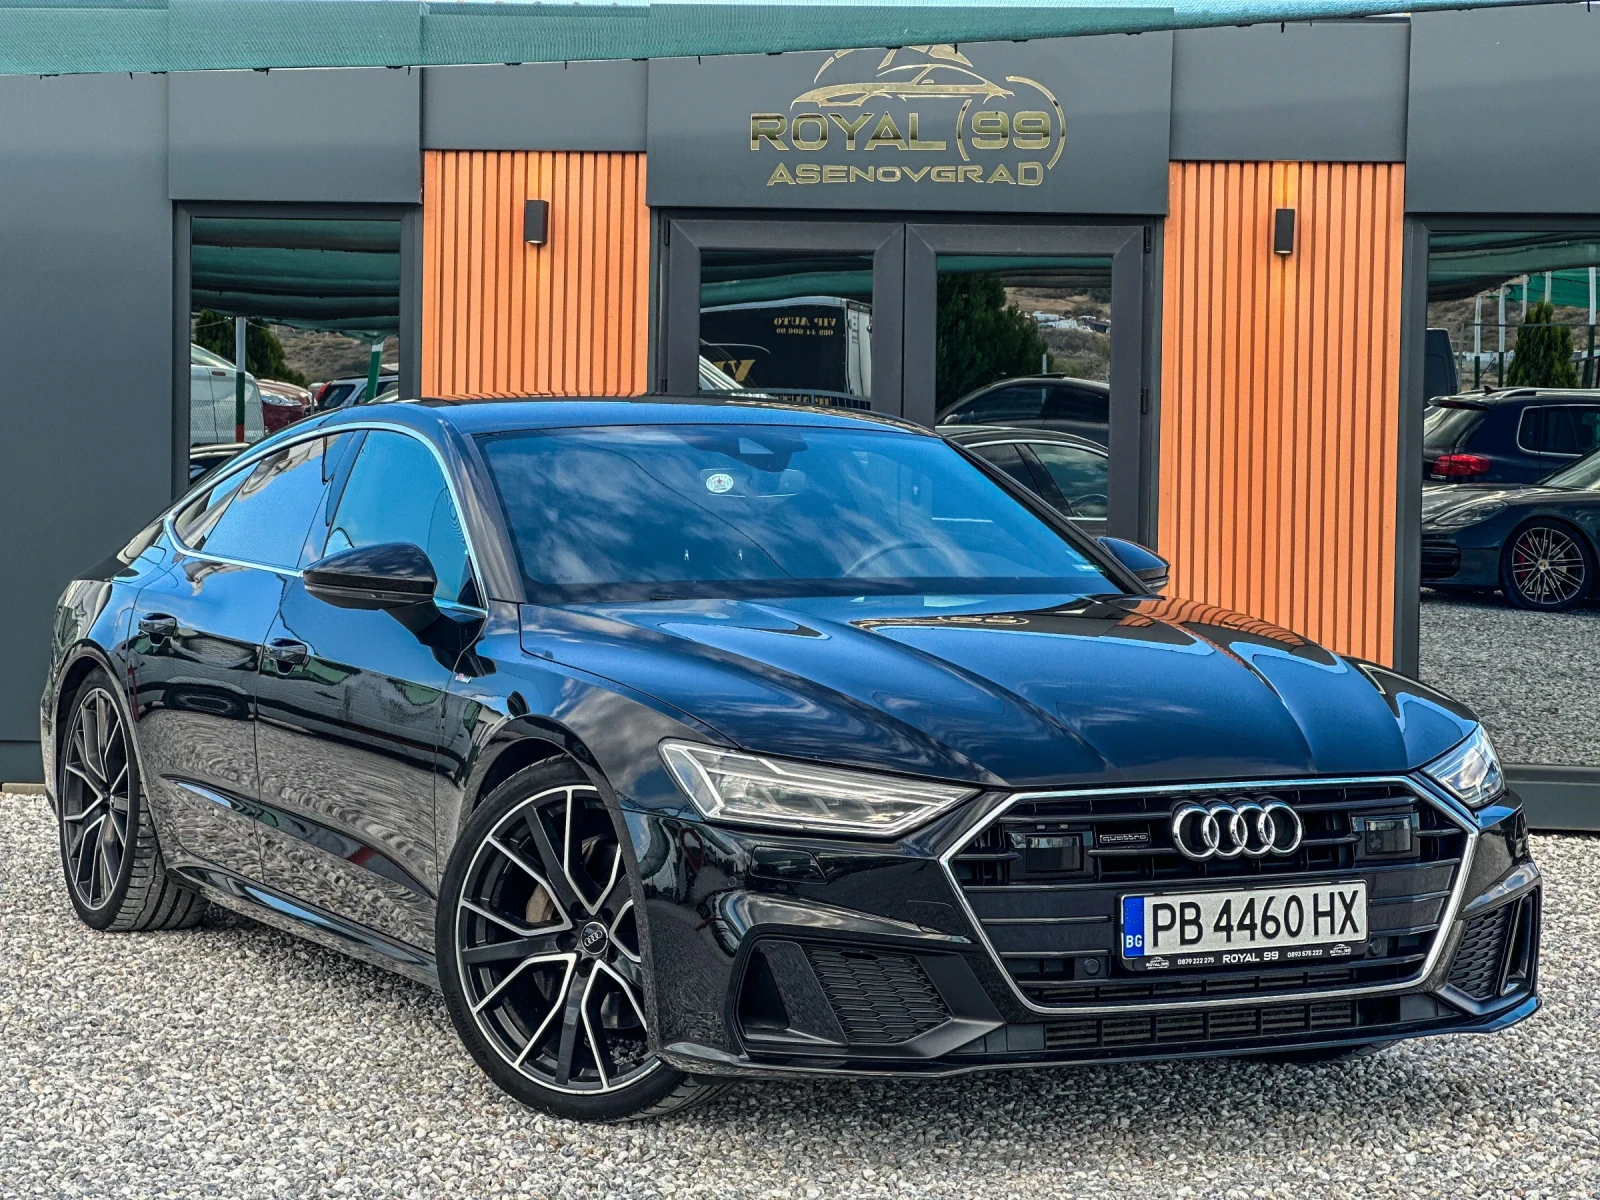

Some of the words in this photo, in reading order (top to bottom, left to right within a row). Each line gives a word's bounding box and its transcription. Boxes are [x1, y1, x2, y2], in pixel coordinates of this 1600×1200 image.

[750, 111, 946, 151] ROYAL
[767, 161, 1044, 186] ASENOVGRAD
[1102, 834, 1147, 843] quattro
[1152, 901, 1204, 948] PB
[1213, 894, 1305, 943] 4460
[1313, 889, 1360, 937] HX
[1126, 935, 1143, 948] BG
[1177, 958, 1193, 966] 0879
[1192, 957, 1204, 965] 222
[1203, 956, 1215, 964] 275
[1222, 953, 1260, 964] ROYAL
[1263, 951, 1279, 961] 99
